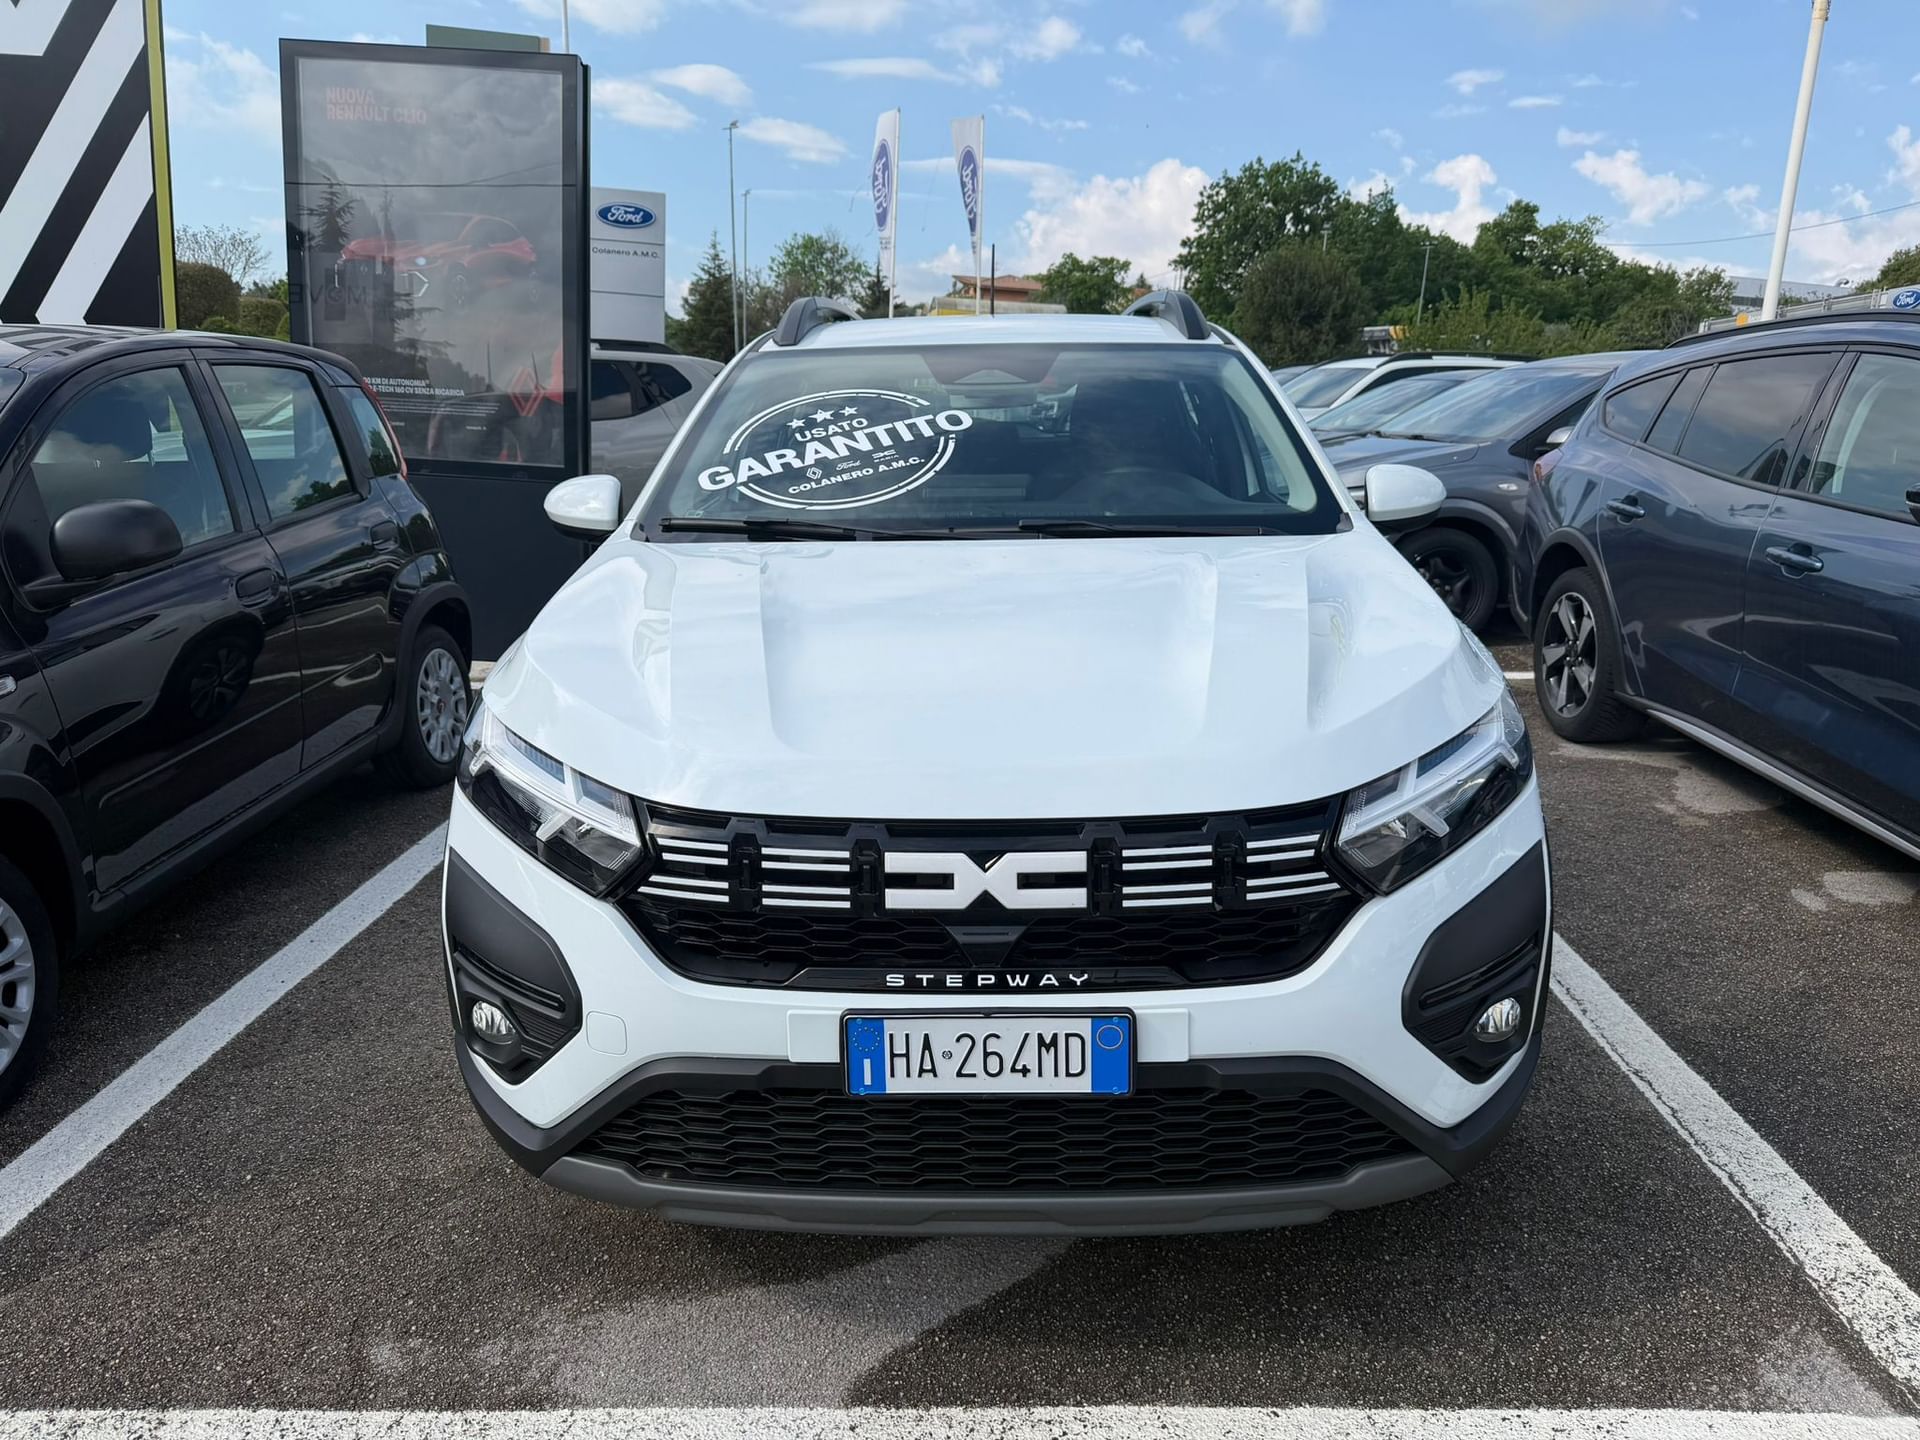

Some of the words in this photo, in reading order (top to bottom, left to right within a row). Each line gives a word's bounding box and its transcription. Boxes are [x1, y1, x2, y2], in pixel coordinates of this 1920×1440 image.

[326, 87, 376, 104] NUOVA
[327, 104, 390, 122] RENAULT
[393, 107, 427, 125] CLIO
[607, 205, 643, 223] Ford
[592, 246, 631, 256] Colanero
[794, 417, 869, 442] USATO
[698, 410, 973, 491] GARANTITO
[788, 468, 874, 494] COLANERO
[878, 456, 925, 473] A.M.C.
[886, 973, 1088, 987] STEPWAY
